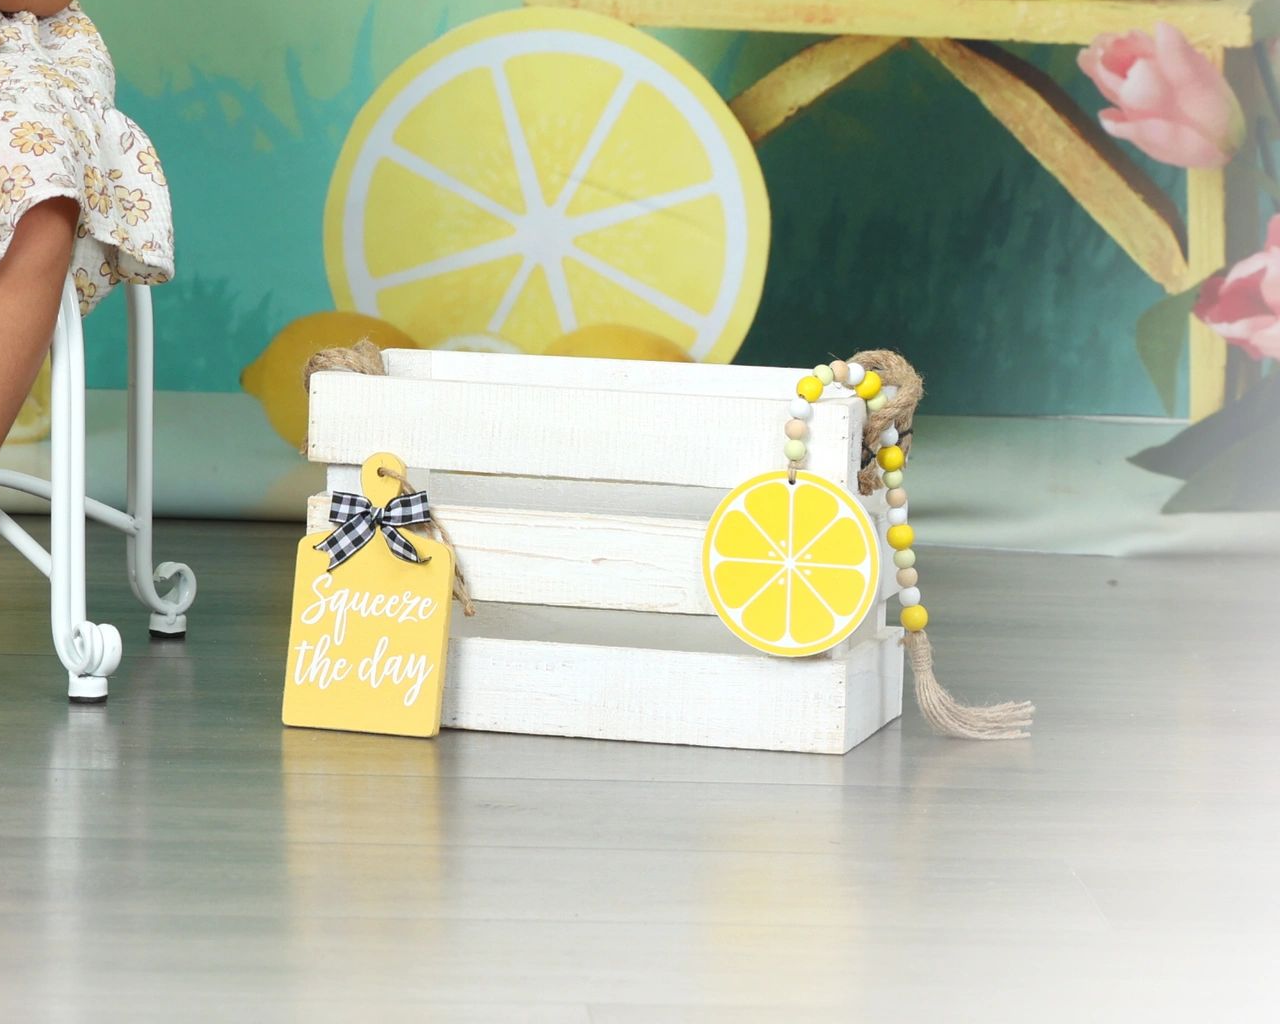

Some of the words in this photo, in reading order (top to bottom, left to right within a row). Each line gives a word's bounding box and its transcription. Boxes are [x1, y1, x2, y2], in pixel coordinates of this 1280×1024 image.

[301, 573, 438, 646] Squeeze
[293, 635, 353, 690] the
[357, 636, 434, 707] day
